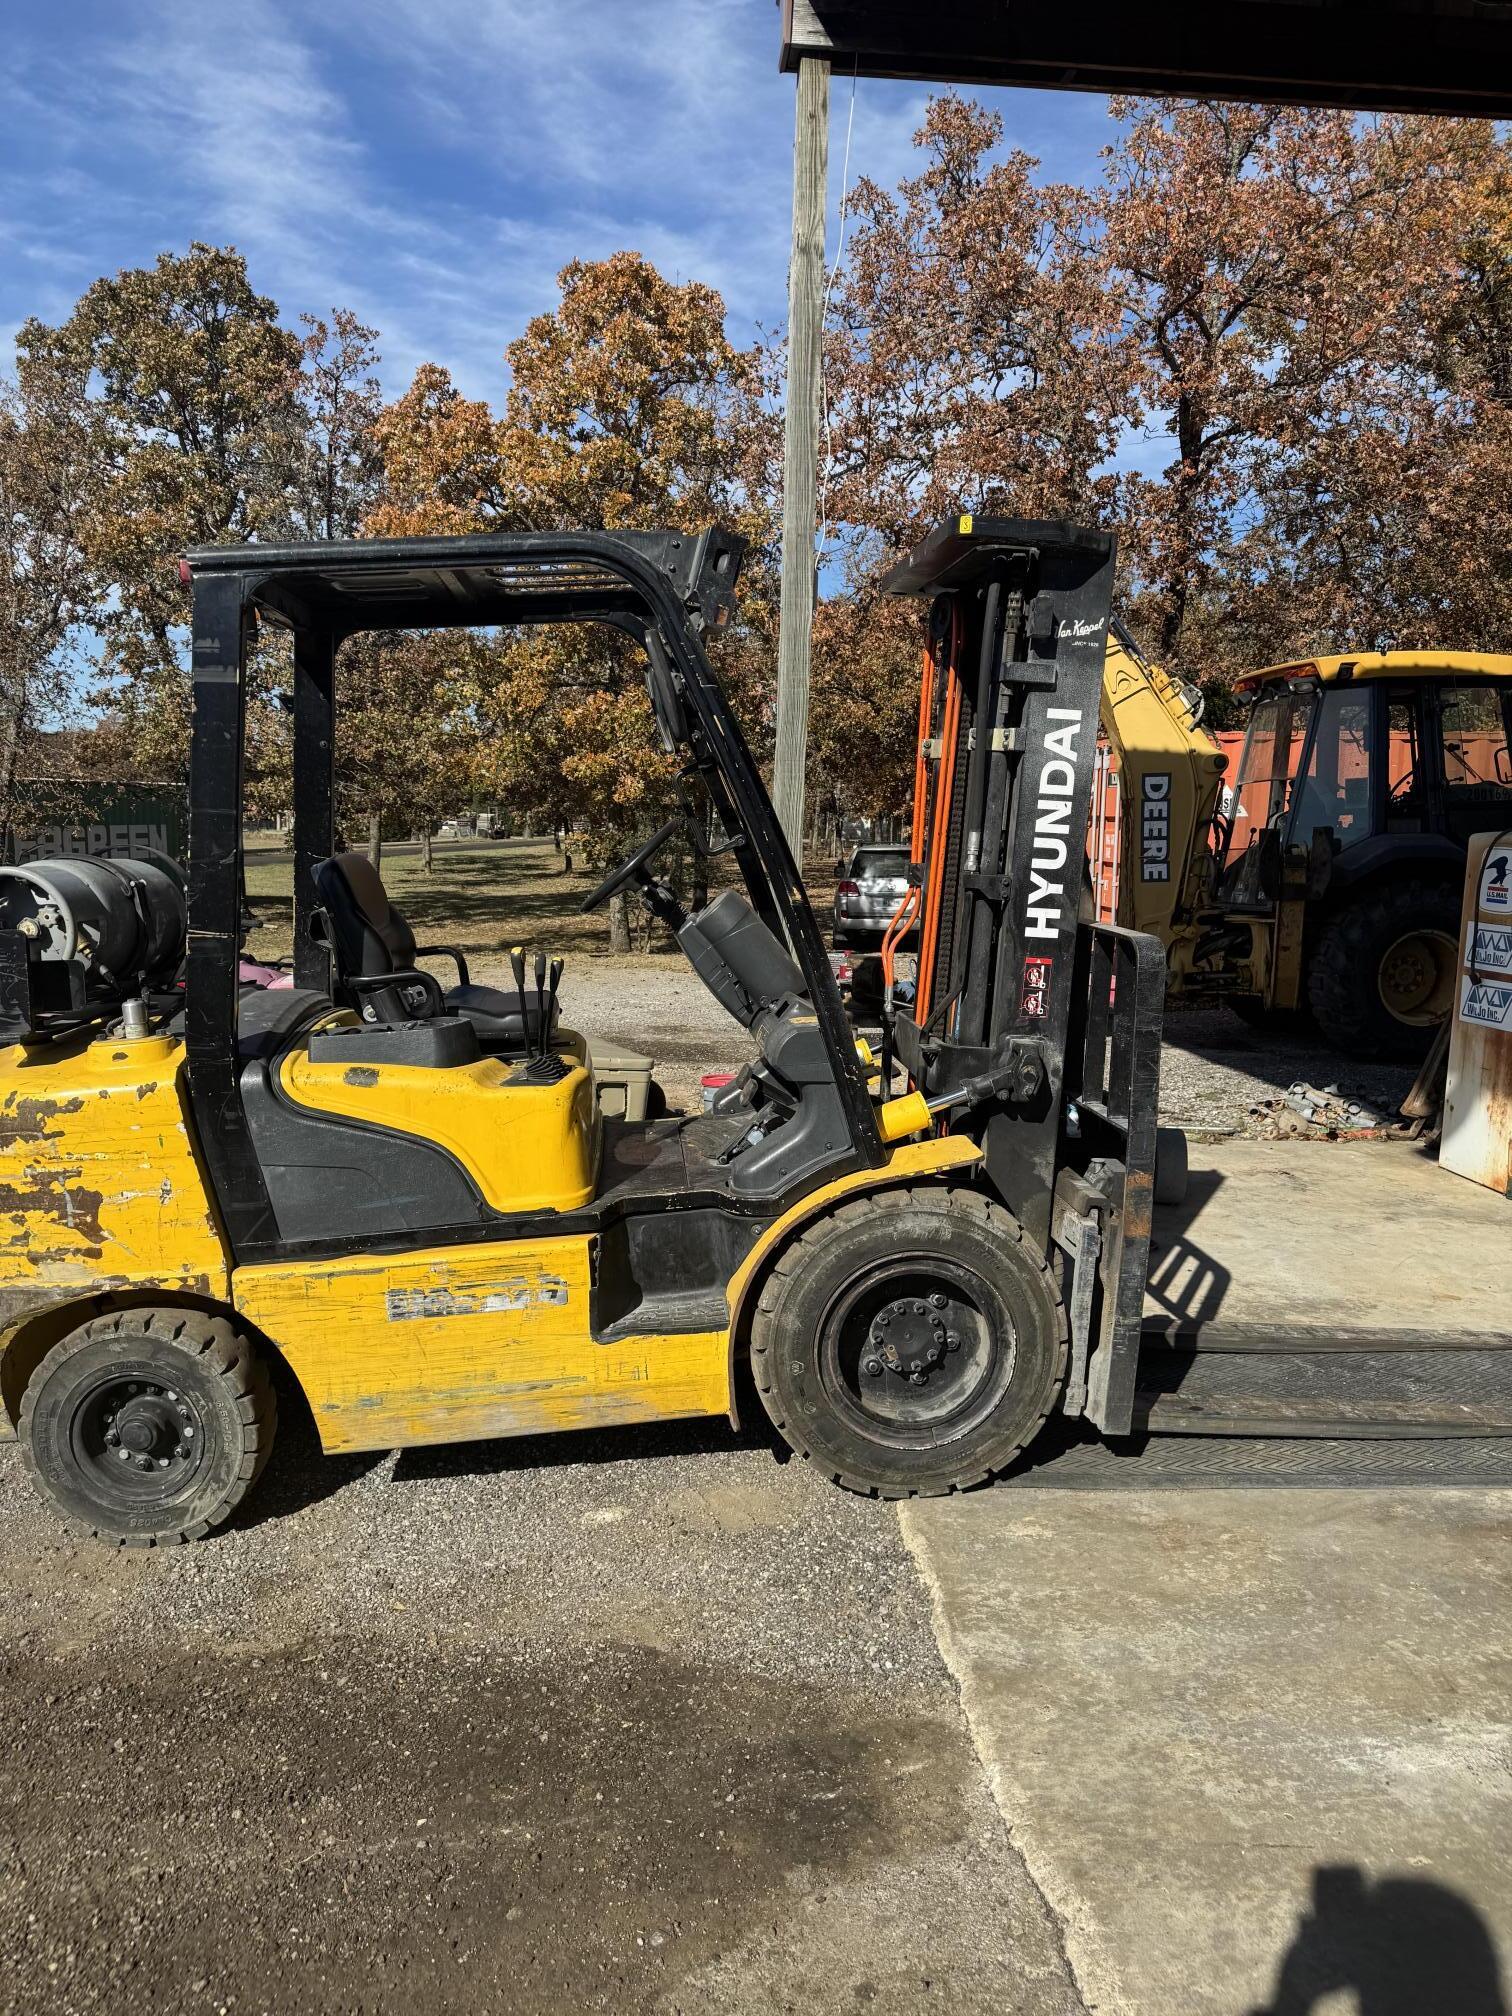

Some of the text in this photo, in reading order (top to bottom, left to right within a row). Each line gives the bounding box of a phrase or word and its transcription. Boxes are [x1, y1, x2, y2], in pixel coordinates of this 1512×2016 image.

[1073, 617, 1104, 636] Keppel
[1024, 707, 1082, 939] HYUNDAI
[1143, 775, 1169, 880] DEERE
